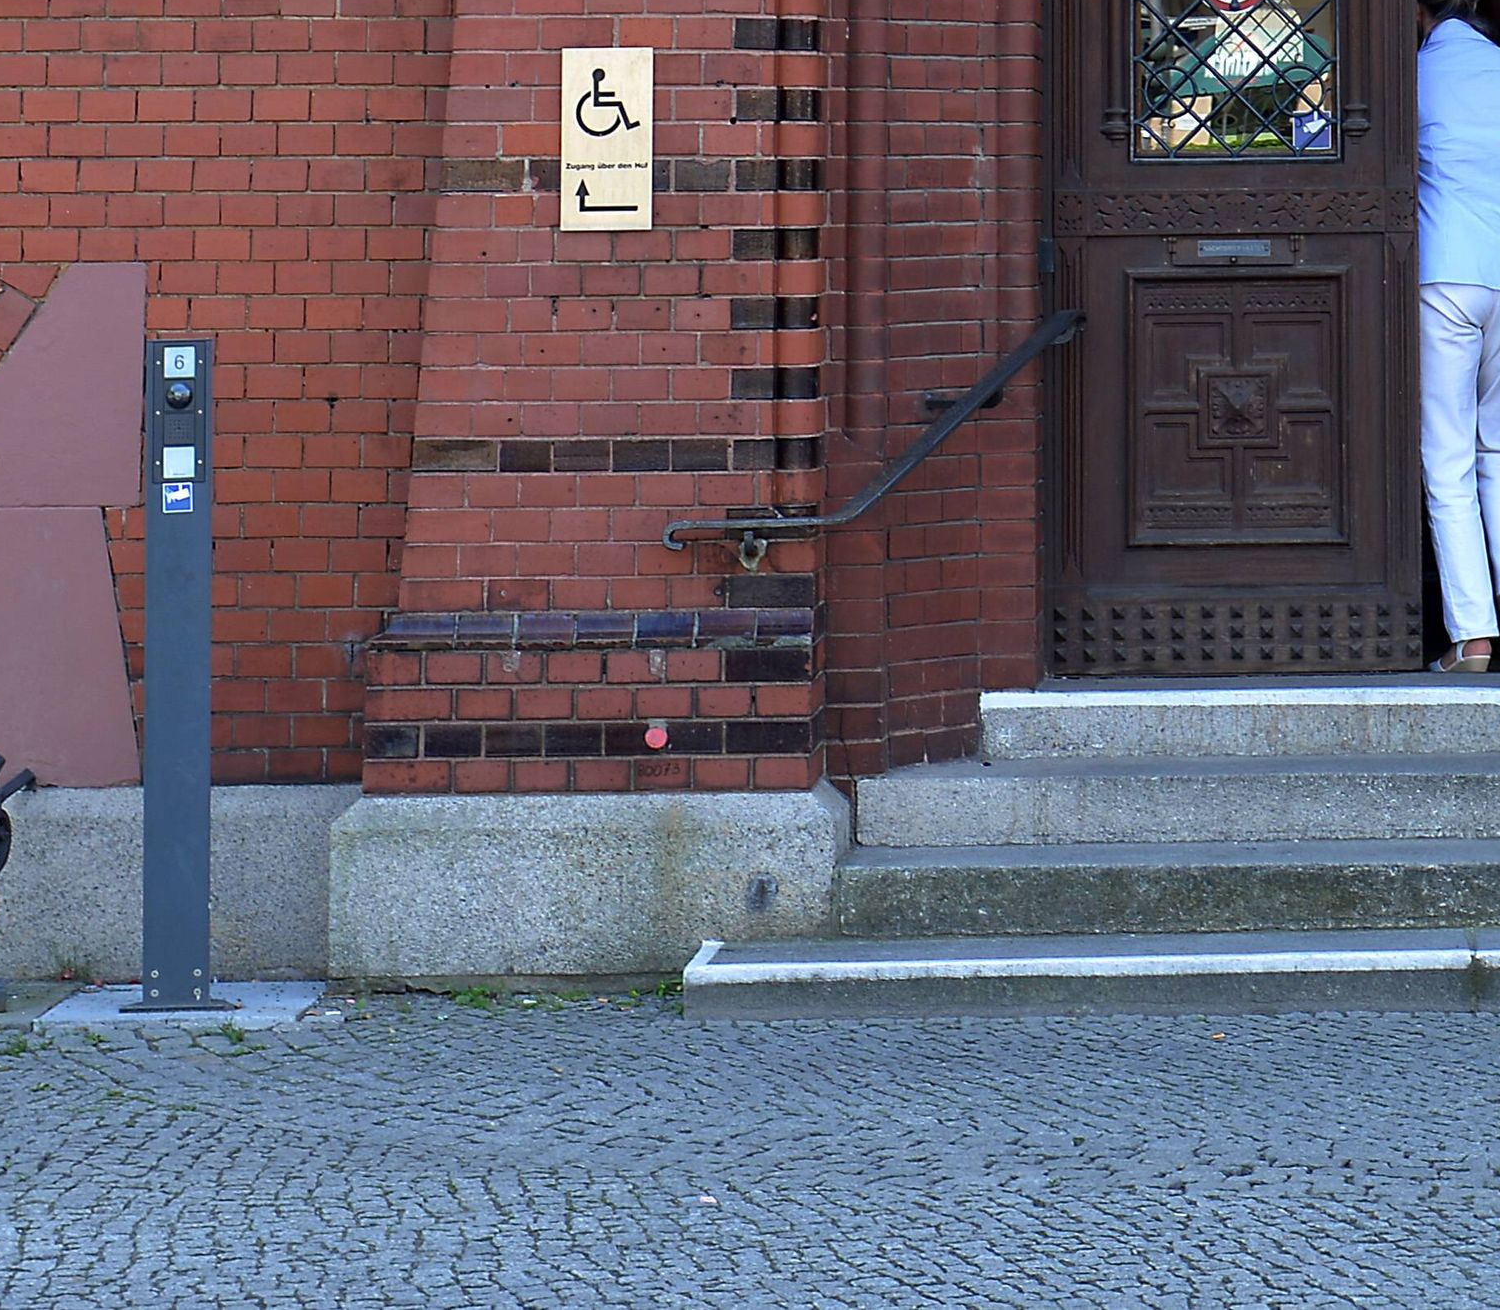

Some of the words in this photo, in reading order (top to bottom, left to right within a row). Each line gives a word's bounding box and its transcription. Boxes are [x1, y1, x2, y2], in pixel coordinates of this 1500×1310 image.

[565, 163, 595, 171] Zugang
[597, 162, 616, 170] über
[173, 354, 185, 370] 6
